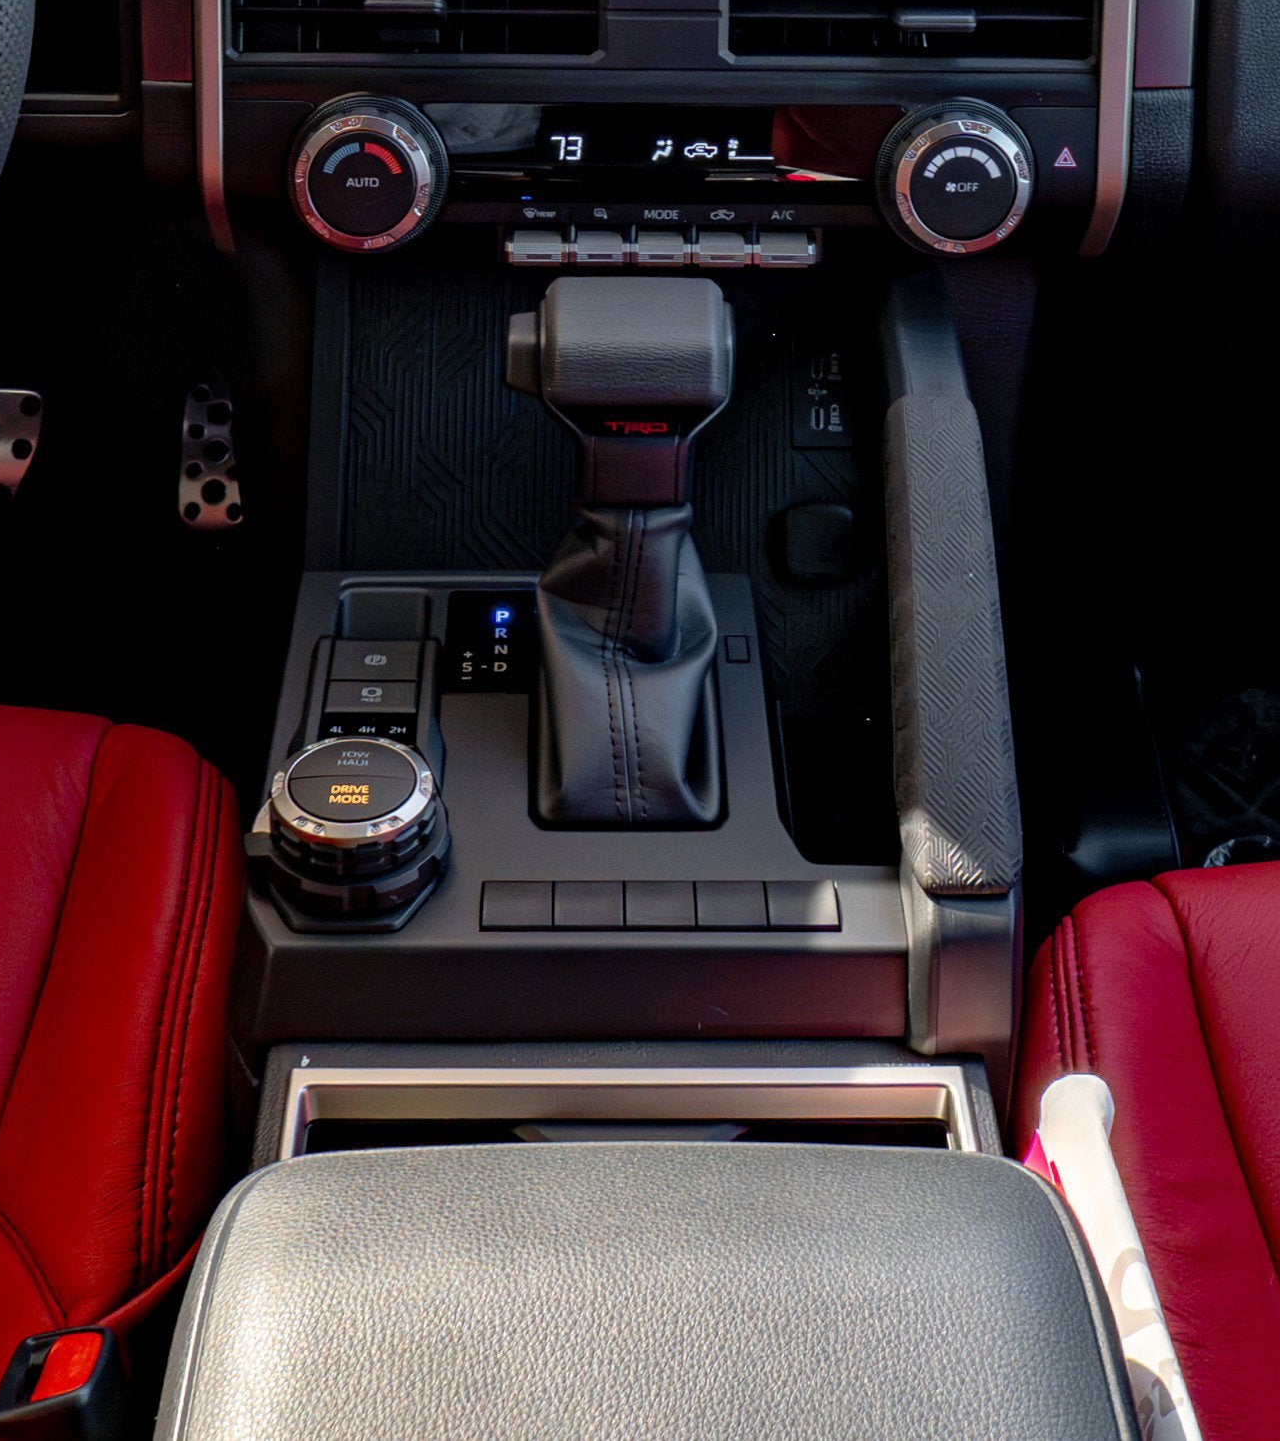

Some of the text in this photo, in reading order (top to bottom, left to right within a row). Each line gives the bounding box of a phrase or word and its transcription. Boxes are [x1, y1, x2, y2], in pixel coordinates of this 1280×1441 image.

[550, 136, 584, 160] 73
[345, 177, 380, 188] AUTO
[957, 182, 979, 193] OFF
[643, 209, 679, 220] MODE
[771, 209, 795, 221] A/C
[602, 421, 668, 435] TRD
[495, 610, 510, 623] P
[494, 627, 508, 639] R
[494, 644, 508, 655] N
[461, 661, 473, 673] S
[493, 661, 508, 673] D
[329, 725, 344, 734] 4L
[358, 725, 376, 734] 4H
[389, 725, 407, 734] 2H
[336, 759, 370, 767] HAUL
[330, 784, 370, 794] DRIVE
[328, 794, 370, 805] MODE
